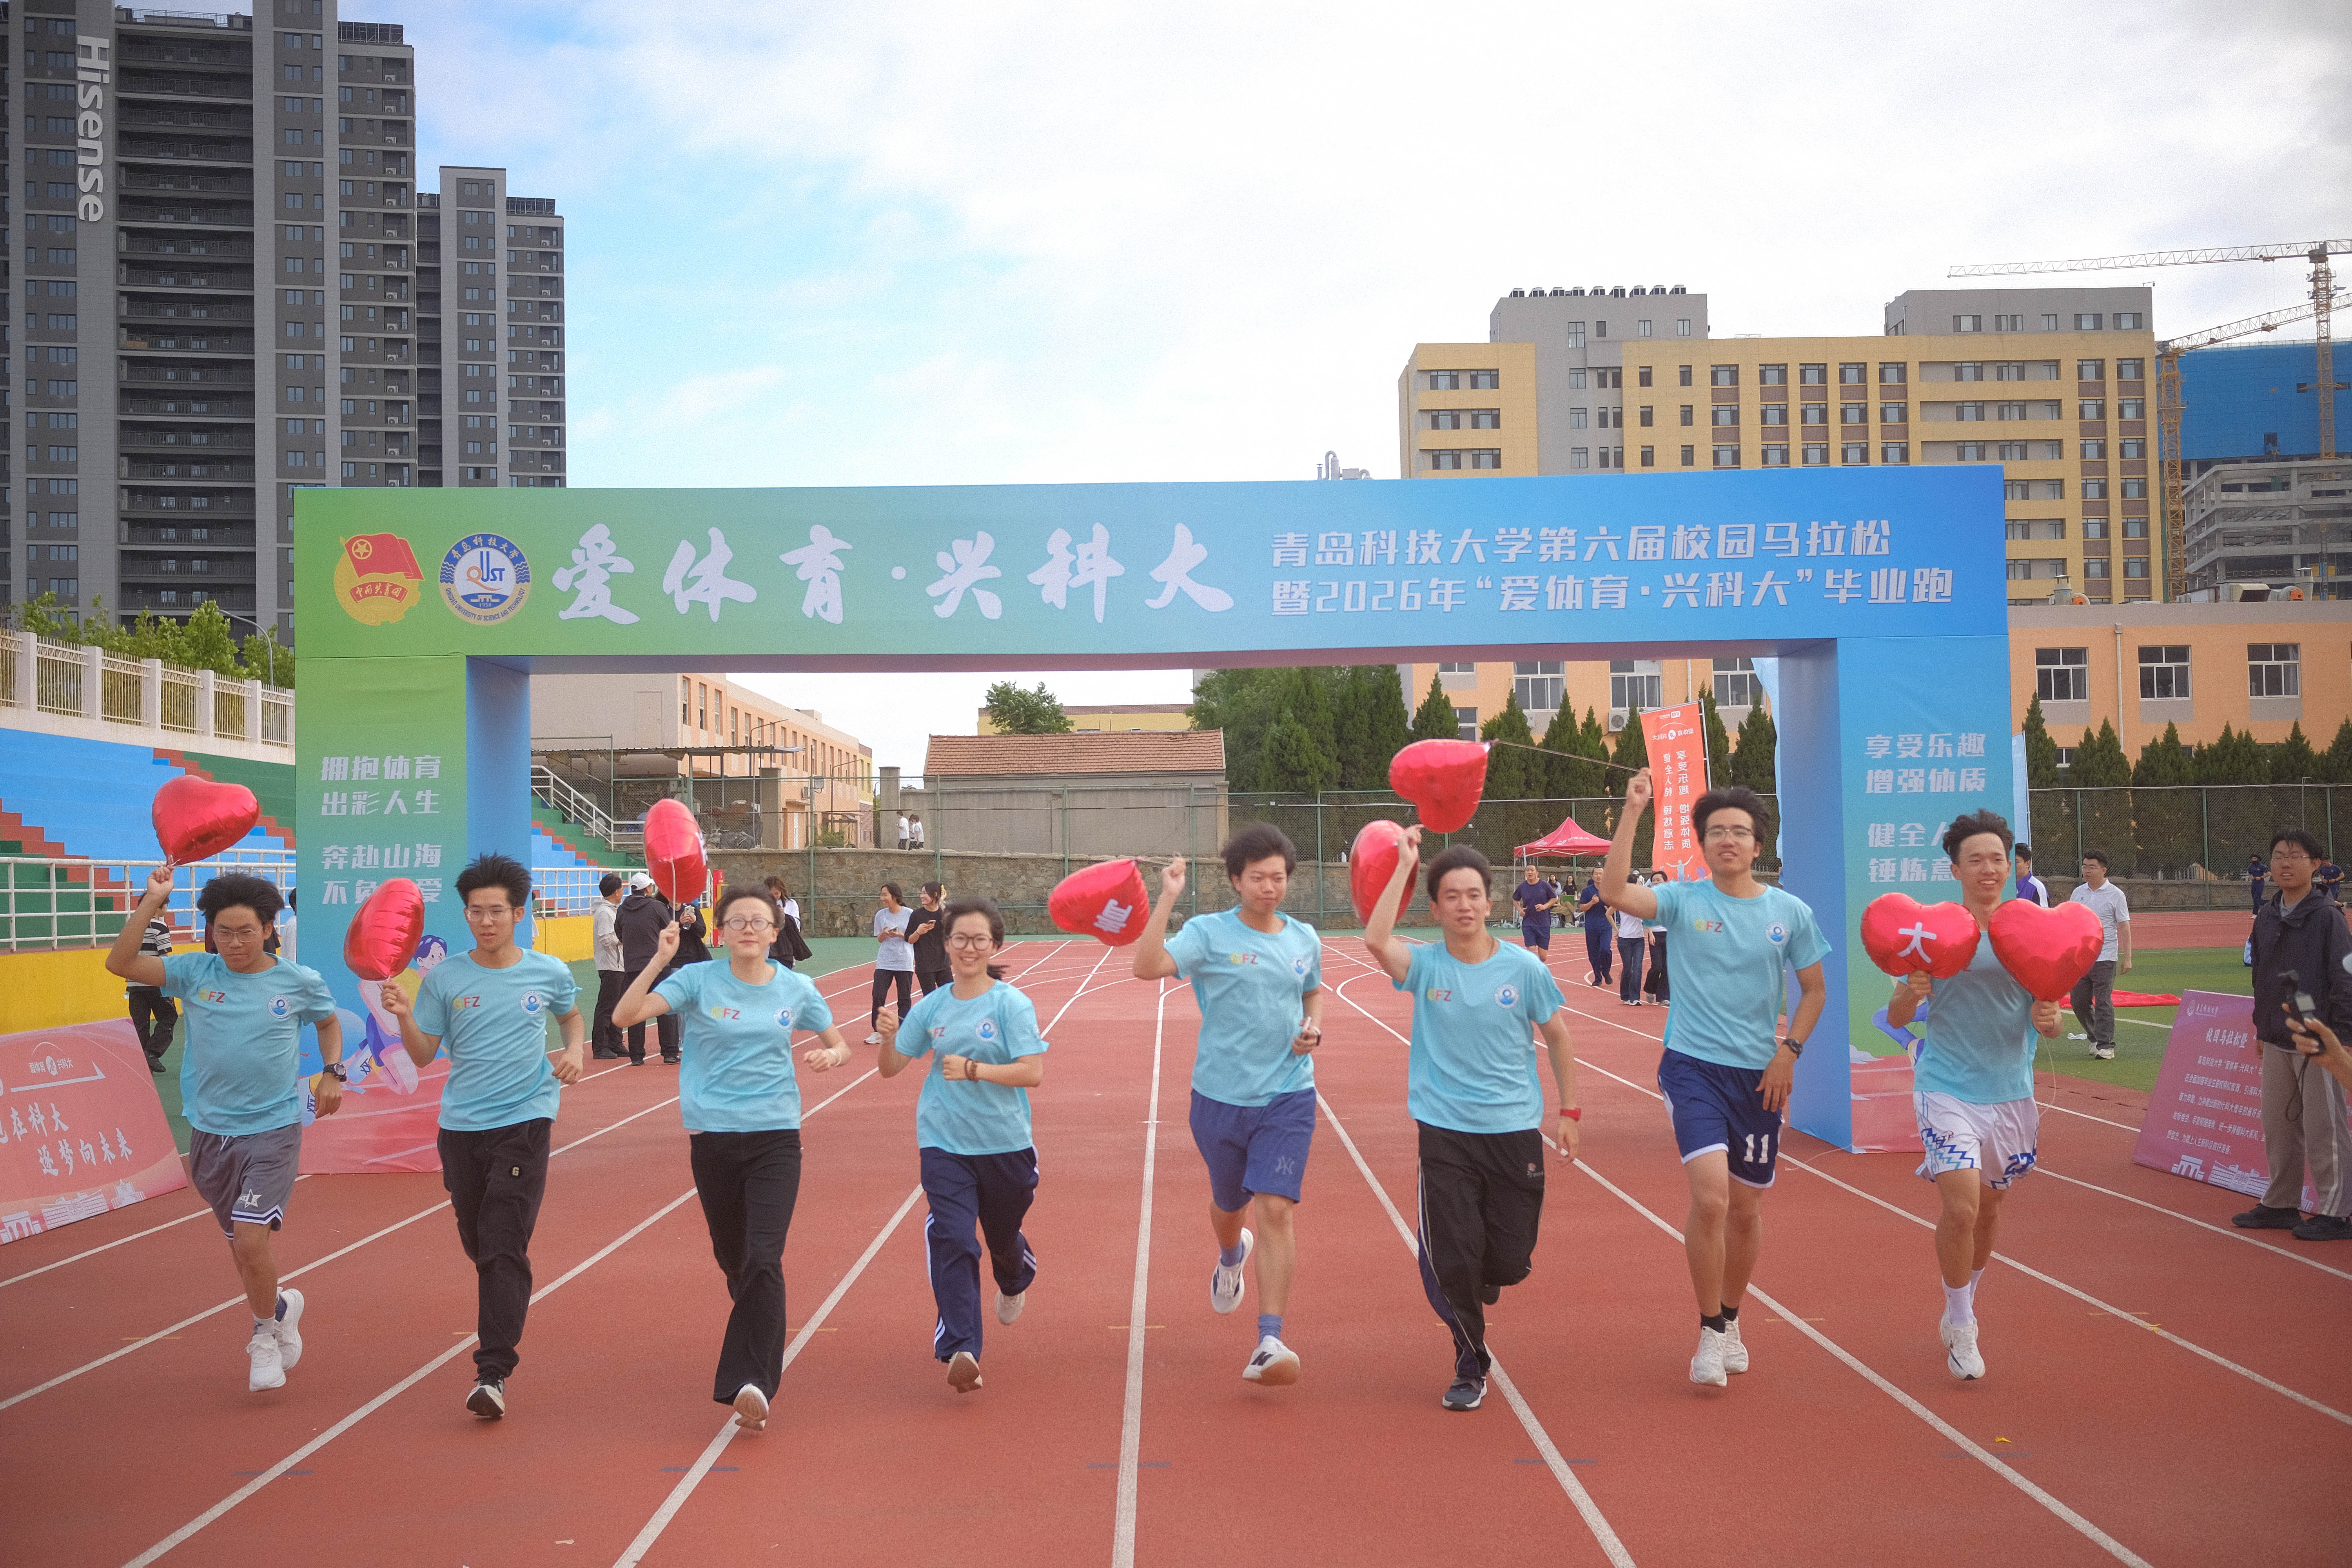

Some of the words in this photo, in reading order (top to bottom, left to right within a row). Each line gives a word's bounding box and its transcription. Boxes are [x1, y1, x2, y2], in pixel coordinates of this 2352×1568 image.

[77, 35, 110, 222] Hisense
[1271, 519, 1890, 568] 青岛科技大学第六届校园马拉松
[465, 551, 505, 591] QUST
[446, 588, 456, 605] QINGDAO
[455, 604, 477, 621] UNIVERSITY
[501, 609, 509, 617] AND
[508, 588, 526, 612] TECHNOLOGY
[1865, 733, 1986, 759] 享受乐趣
[320, 755, 442, 780] 拥抱体育
[1866, 768, 1986, 793] 增强体质
[321, 789, 440, 815] 出彩人生
[321, 843, 442, 869] 奔赴山海
[322, 878, 442, 904] 不负爱
[1897, 922, 1937, 964] 大
[453, 996, 480, 1010] GFZ
[711, 1005, 740, 1020] GFZ
[927, 1027, 946, 1038] FZ
[29, 1062, 46, 1073] 爱体育
[57, 1058, 73, 1069] 兴科大
[37, 1128, 133, 1176] 逐梦向未来
[1743, 1134, 1769, 1163] 11
[512, 1167, 519, 1176] G
